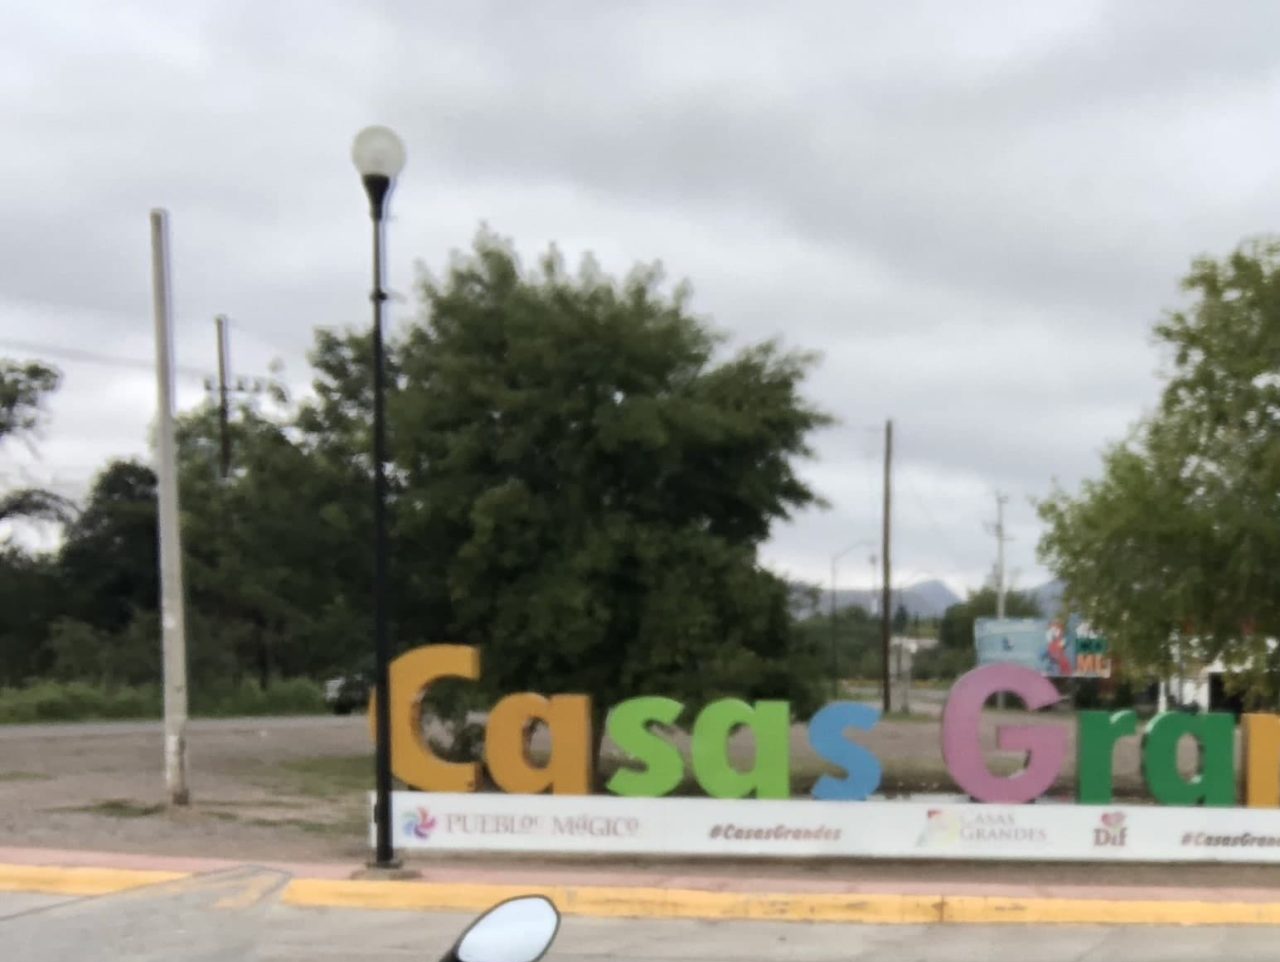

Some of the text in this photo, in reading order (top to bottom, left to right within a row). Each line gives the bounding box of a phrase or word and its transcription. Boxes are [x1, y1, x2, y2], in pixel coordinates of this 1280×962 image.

[370, 643, 882, 800] Casas
[710, 824, 842, 840] #CasasGrandes
[960, 826, 1047, 842] GRANDES
